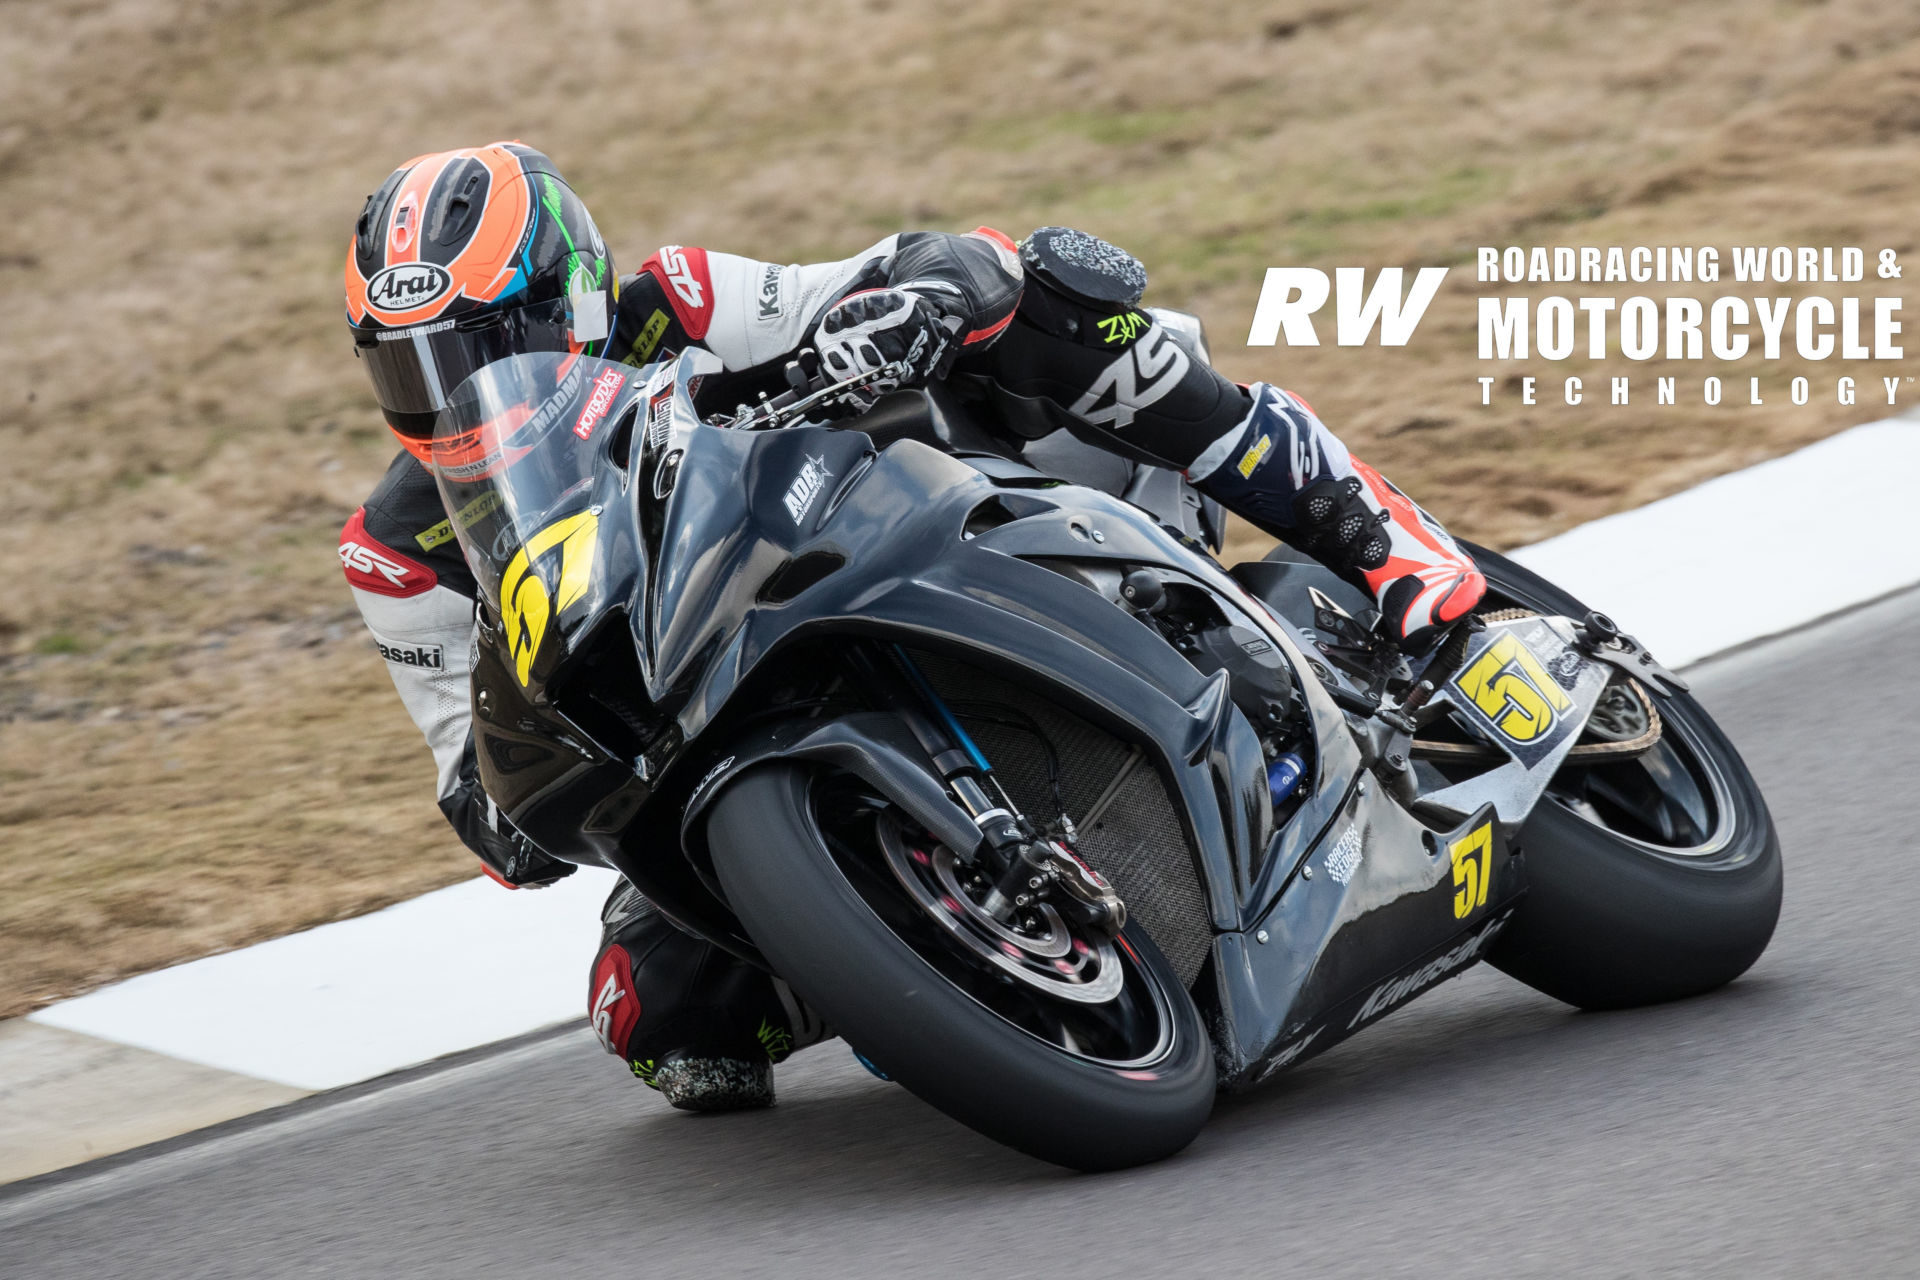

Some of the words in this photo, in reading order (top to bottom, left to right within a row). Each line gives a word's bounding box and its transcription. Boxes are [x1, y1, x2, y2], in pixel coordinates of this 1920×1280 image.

[372, 267, 440, 303] Arai
[390, 295, 424, 306] HELMET
[375, 318, 456, 342] @BRADLEYWARD57
[577, 368, 618, 437] HOTBODIES
[656, 400, 672, 444] WARD57
[783, 462, 818, 519] ADR
[338, 541, 410, 589] 4SR
[377, 643, 441, 668] asaki
[1456, 633, 1573, 741] 57
[1448, 820, 1492, 919] 57
